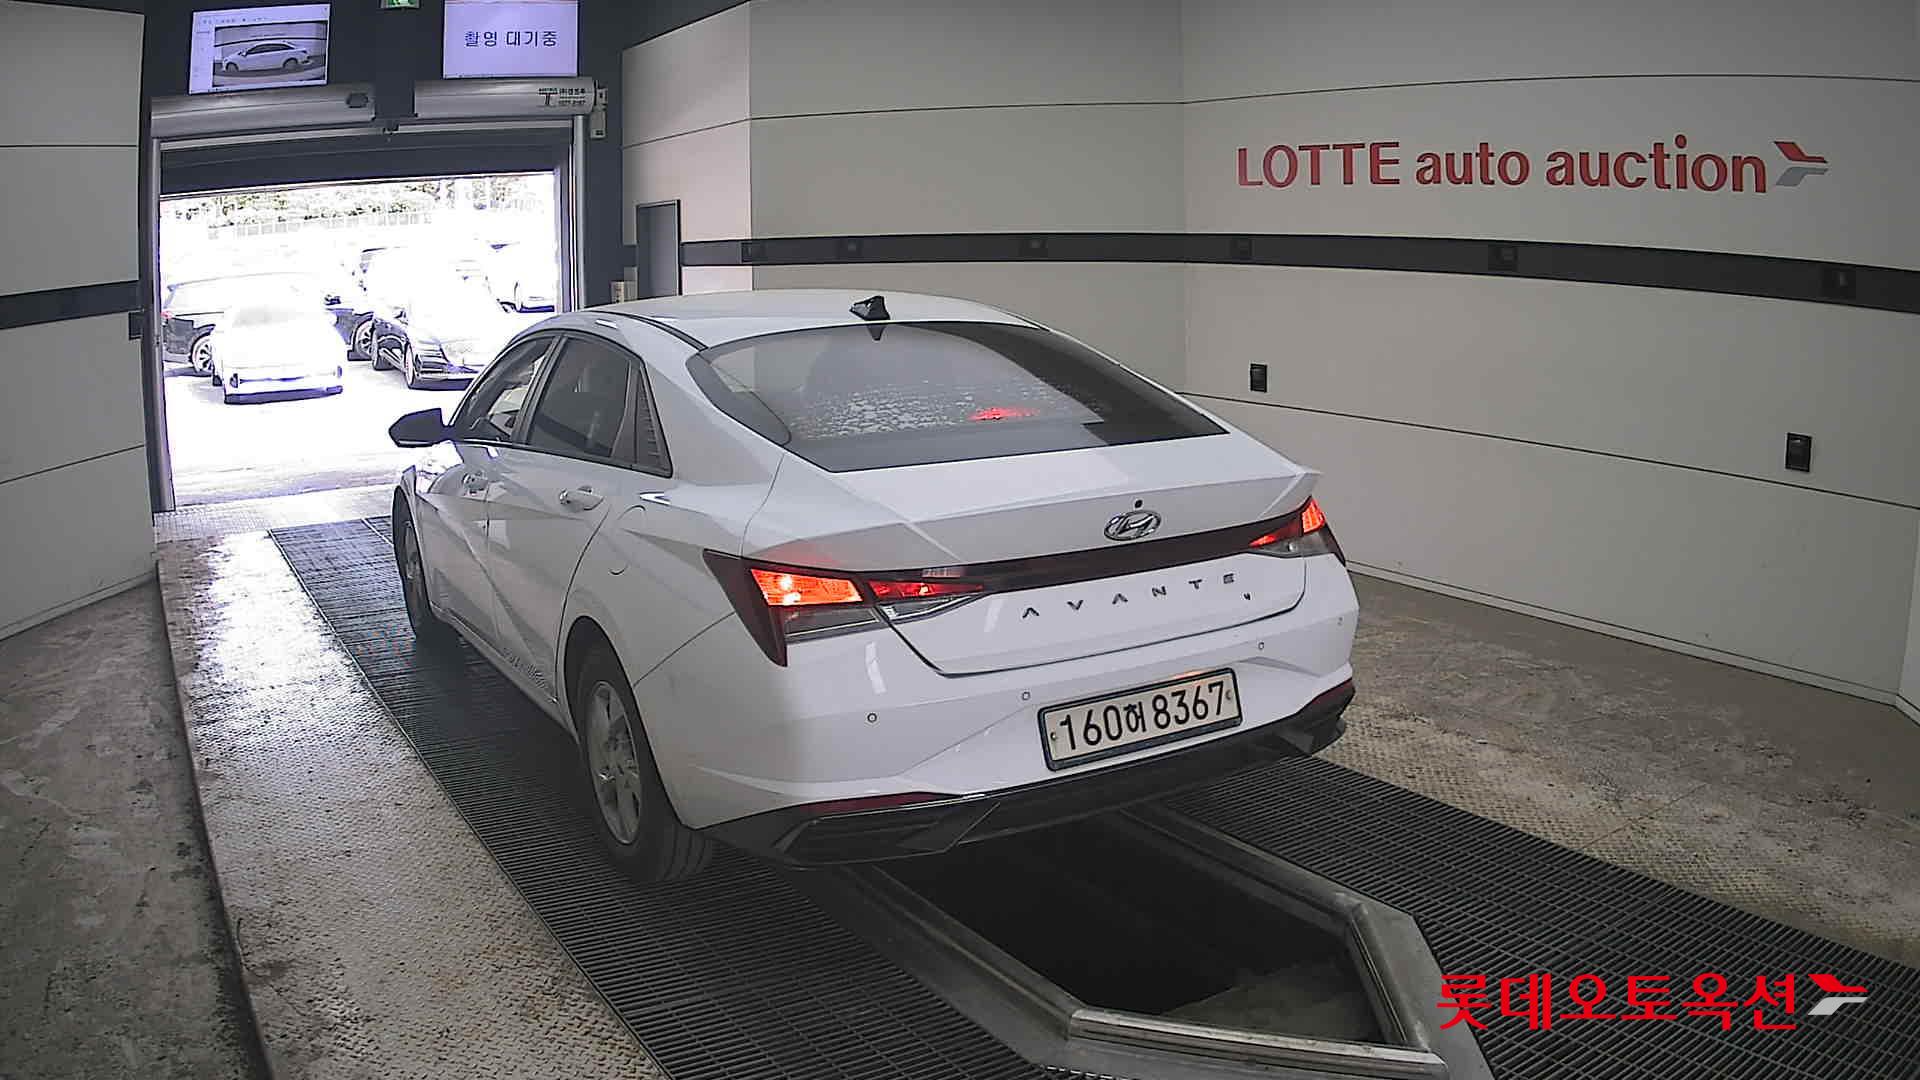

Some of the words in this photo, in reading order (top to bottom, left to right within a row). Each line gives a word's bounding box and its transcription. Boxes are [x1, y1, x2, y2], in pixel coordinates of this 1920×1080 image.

[464, 31, 497, 47] 촬영
[506, 31, 557, 47] 대기중
[1237, 141, 1400, 188] LOTTE
[1415, 142, 1530, 186] auto
[1546, 134, 1767, 193] auction
[1022, 573, 1235, 618] AVANTE
